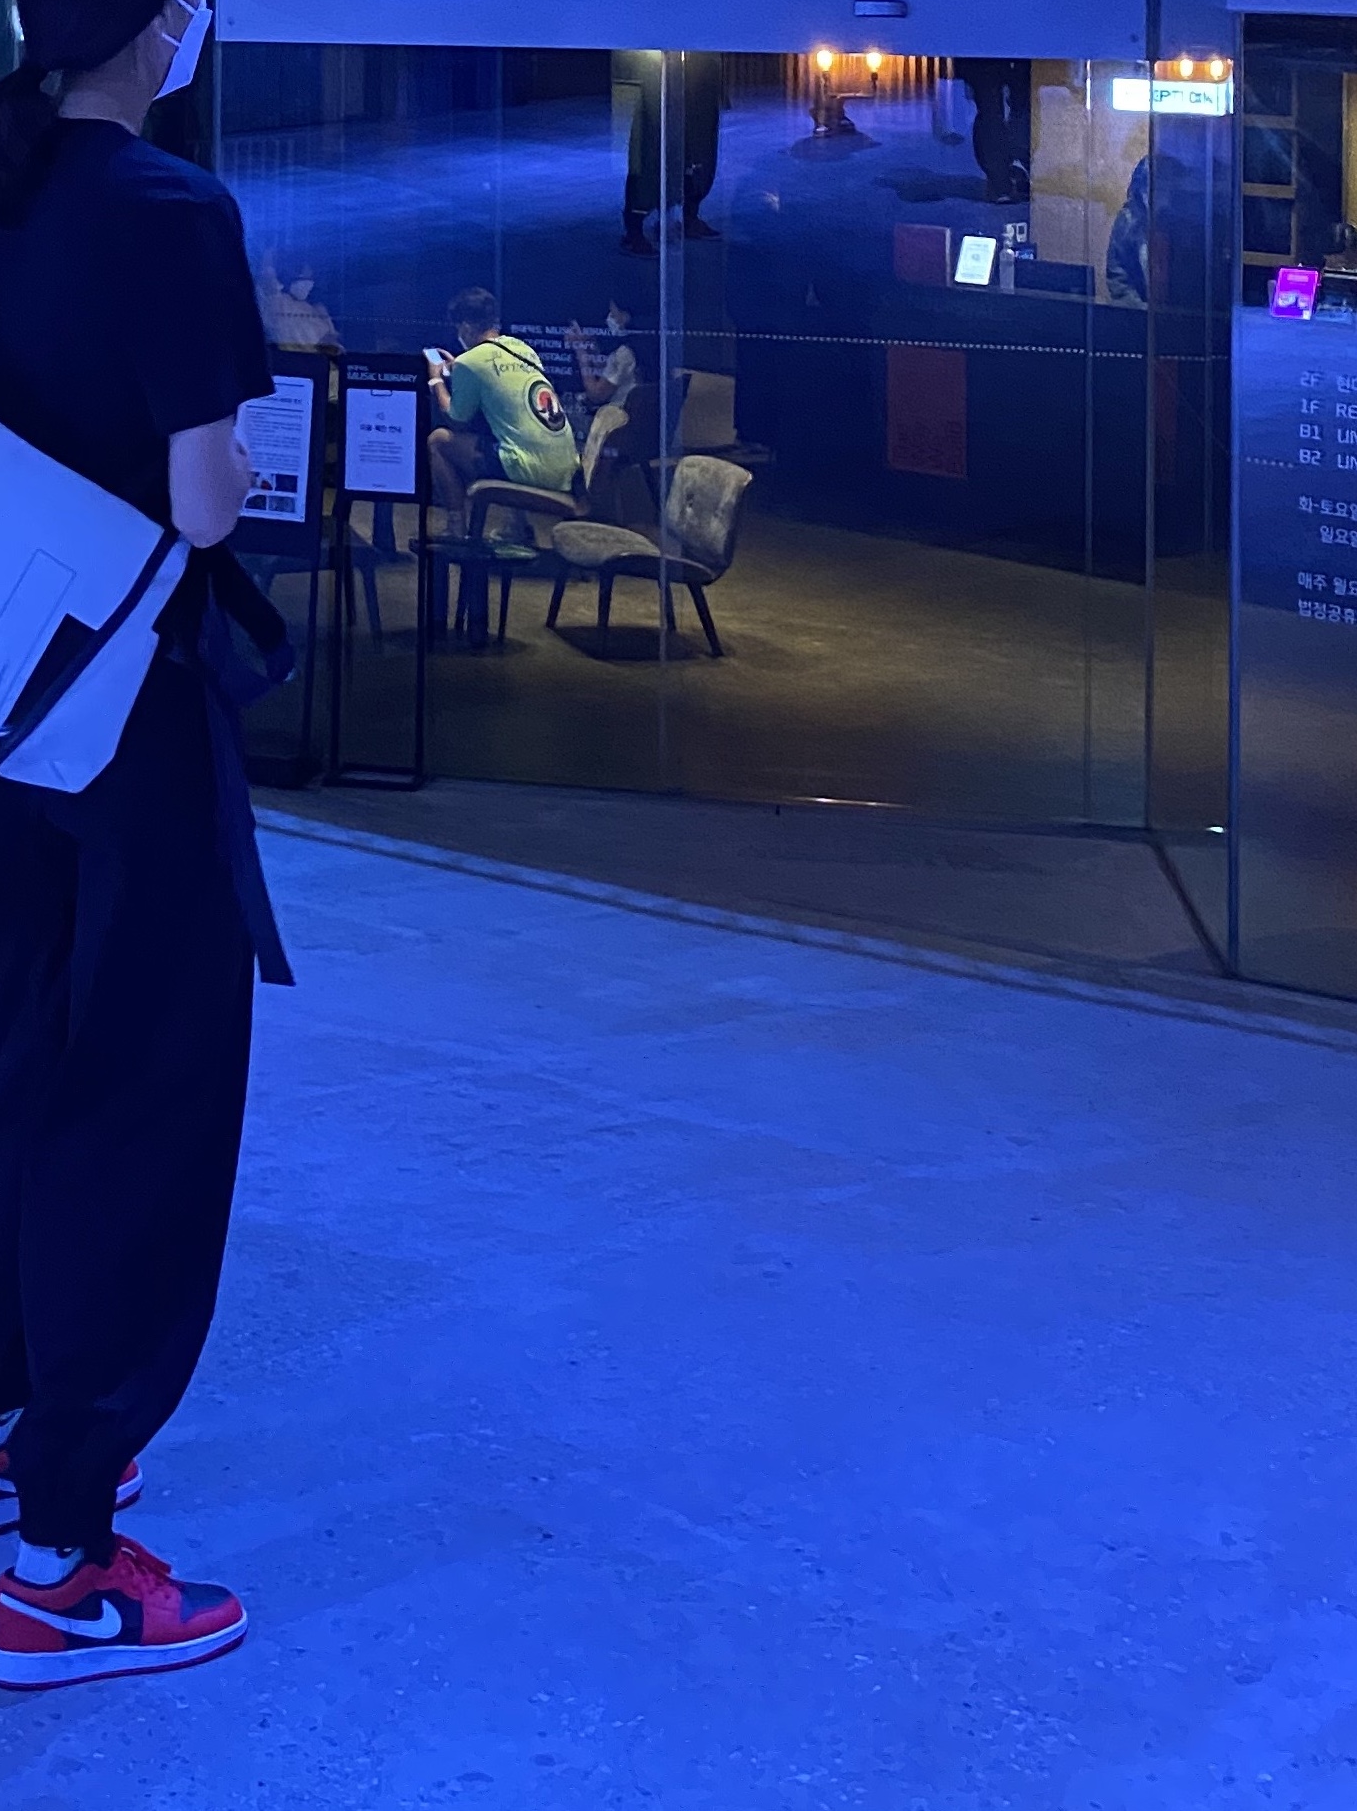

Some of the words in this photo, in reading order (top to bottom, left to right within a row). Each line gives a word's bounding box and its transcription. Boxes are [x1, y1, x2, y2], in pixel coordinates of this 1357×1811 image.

[1300, 398, 1320, 415] 1F
[1299, 423, 1322, 441] B1
[1299, 448, 1322, 466] B2
